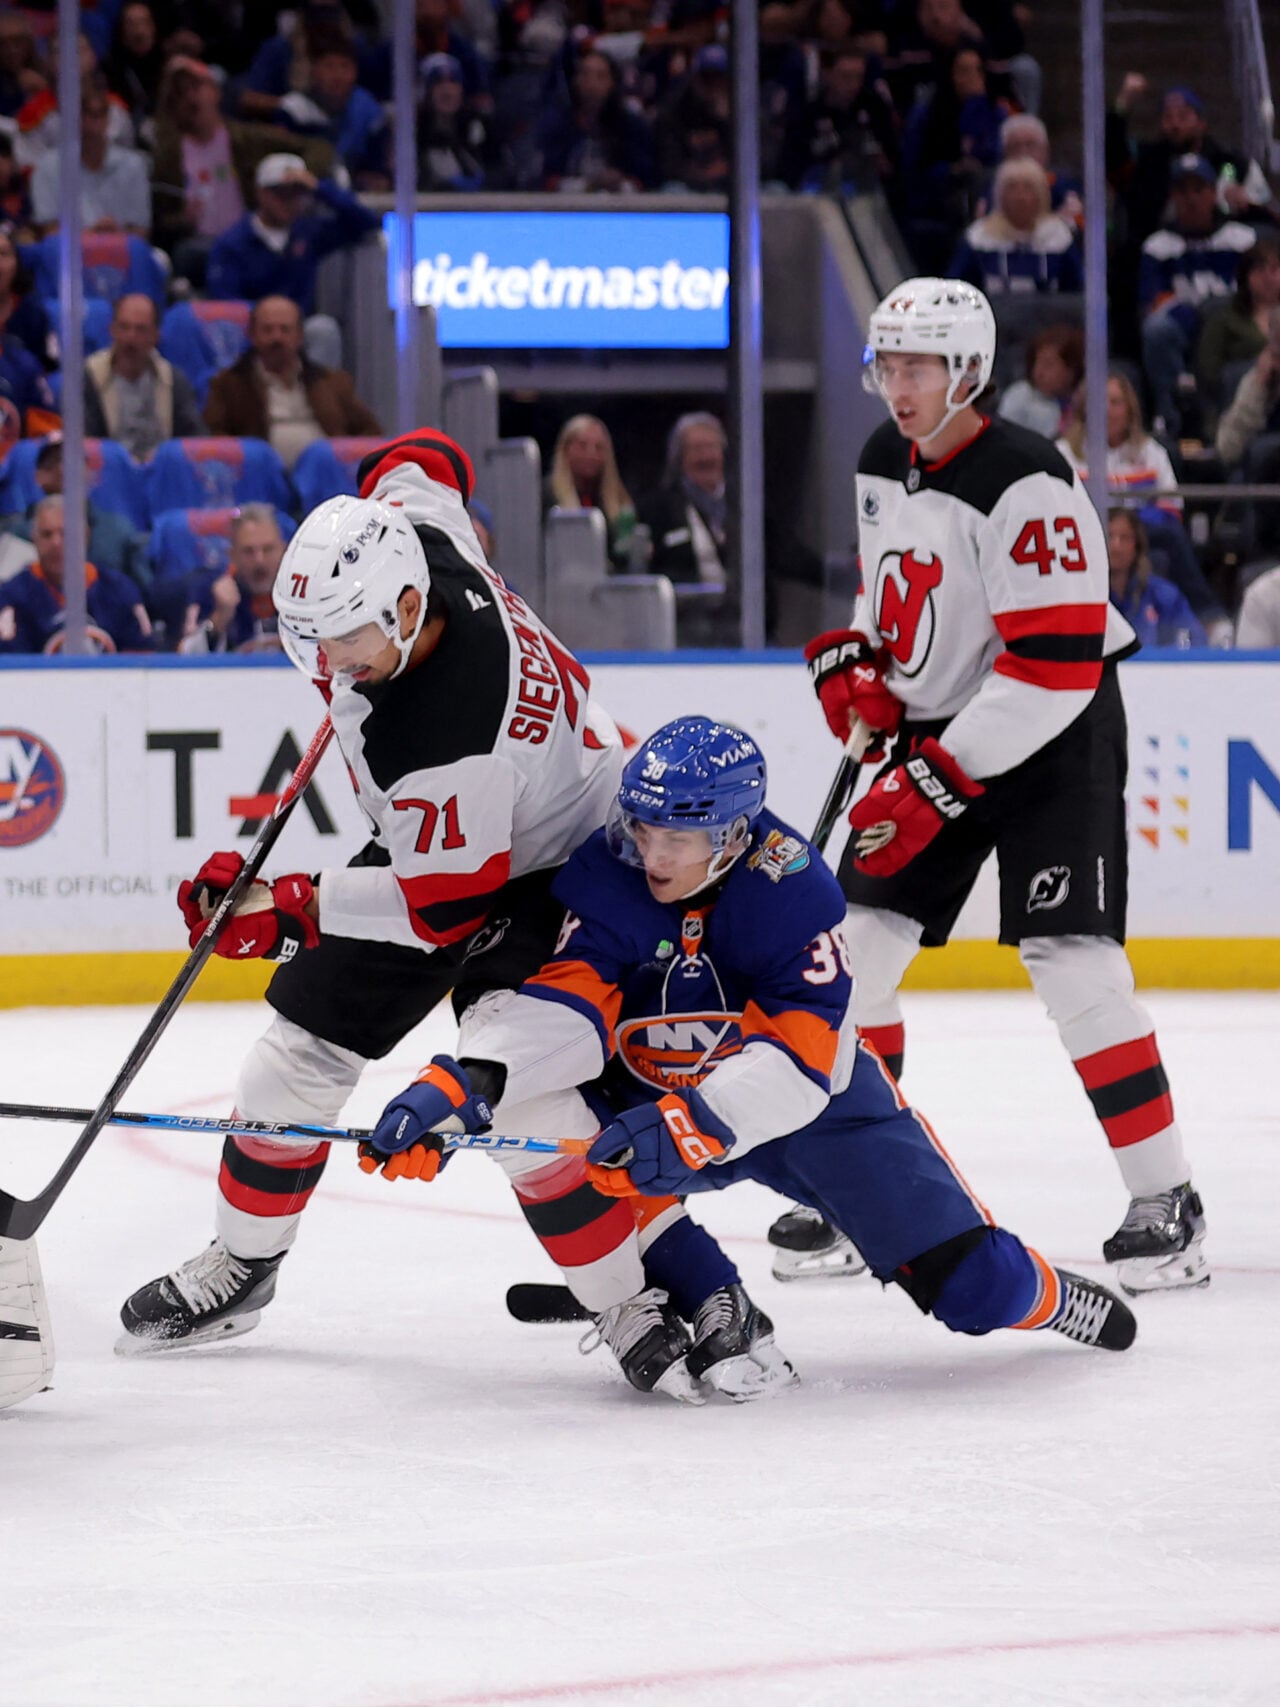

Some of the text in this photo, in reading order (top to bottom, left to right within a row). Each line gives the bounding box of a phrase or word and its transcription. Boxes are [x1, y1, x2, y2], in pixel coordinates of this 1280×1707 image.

[413, 253, 729, 309] ticketmaster
[1010, 517, 1087, 576] 43
[290, 573, 309, 599] 71
[475, 562, 561, 745] SIEGENTH
[809, 641, 861, 680] UER
[642, 760, 668, 781] 38
[630, 789, 665, 808] CCM
[392, 795, 466, 854] 71
[6, 875, 49, 898] THE
[56, 873, 159, 897] OFFICIAL
[178, 1115, 289, 1134] JETSPEED
[395, 1114, 410, 1140] CCM
[441, 1133, 529, 1151] CCM
